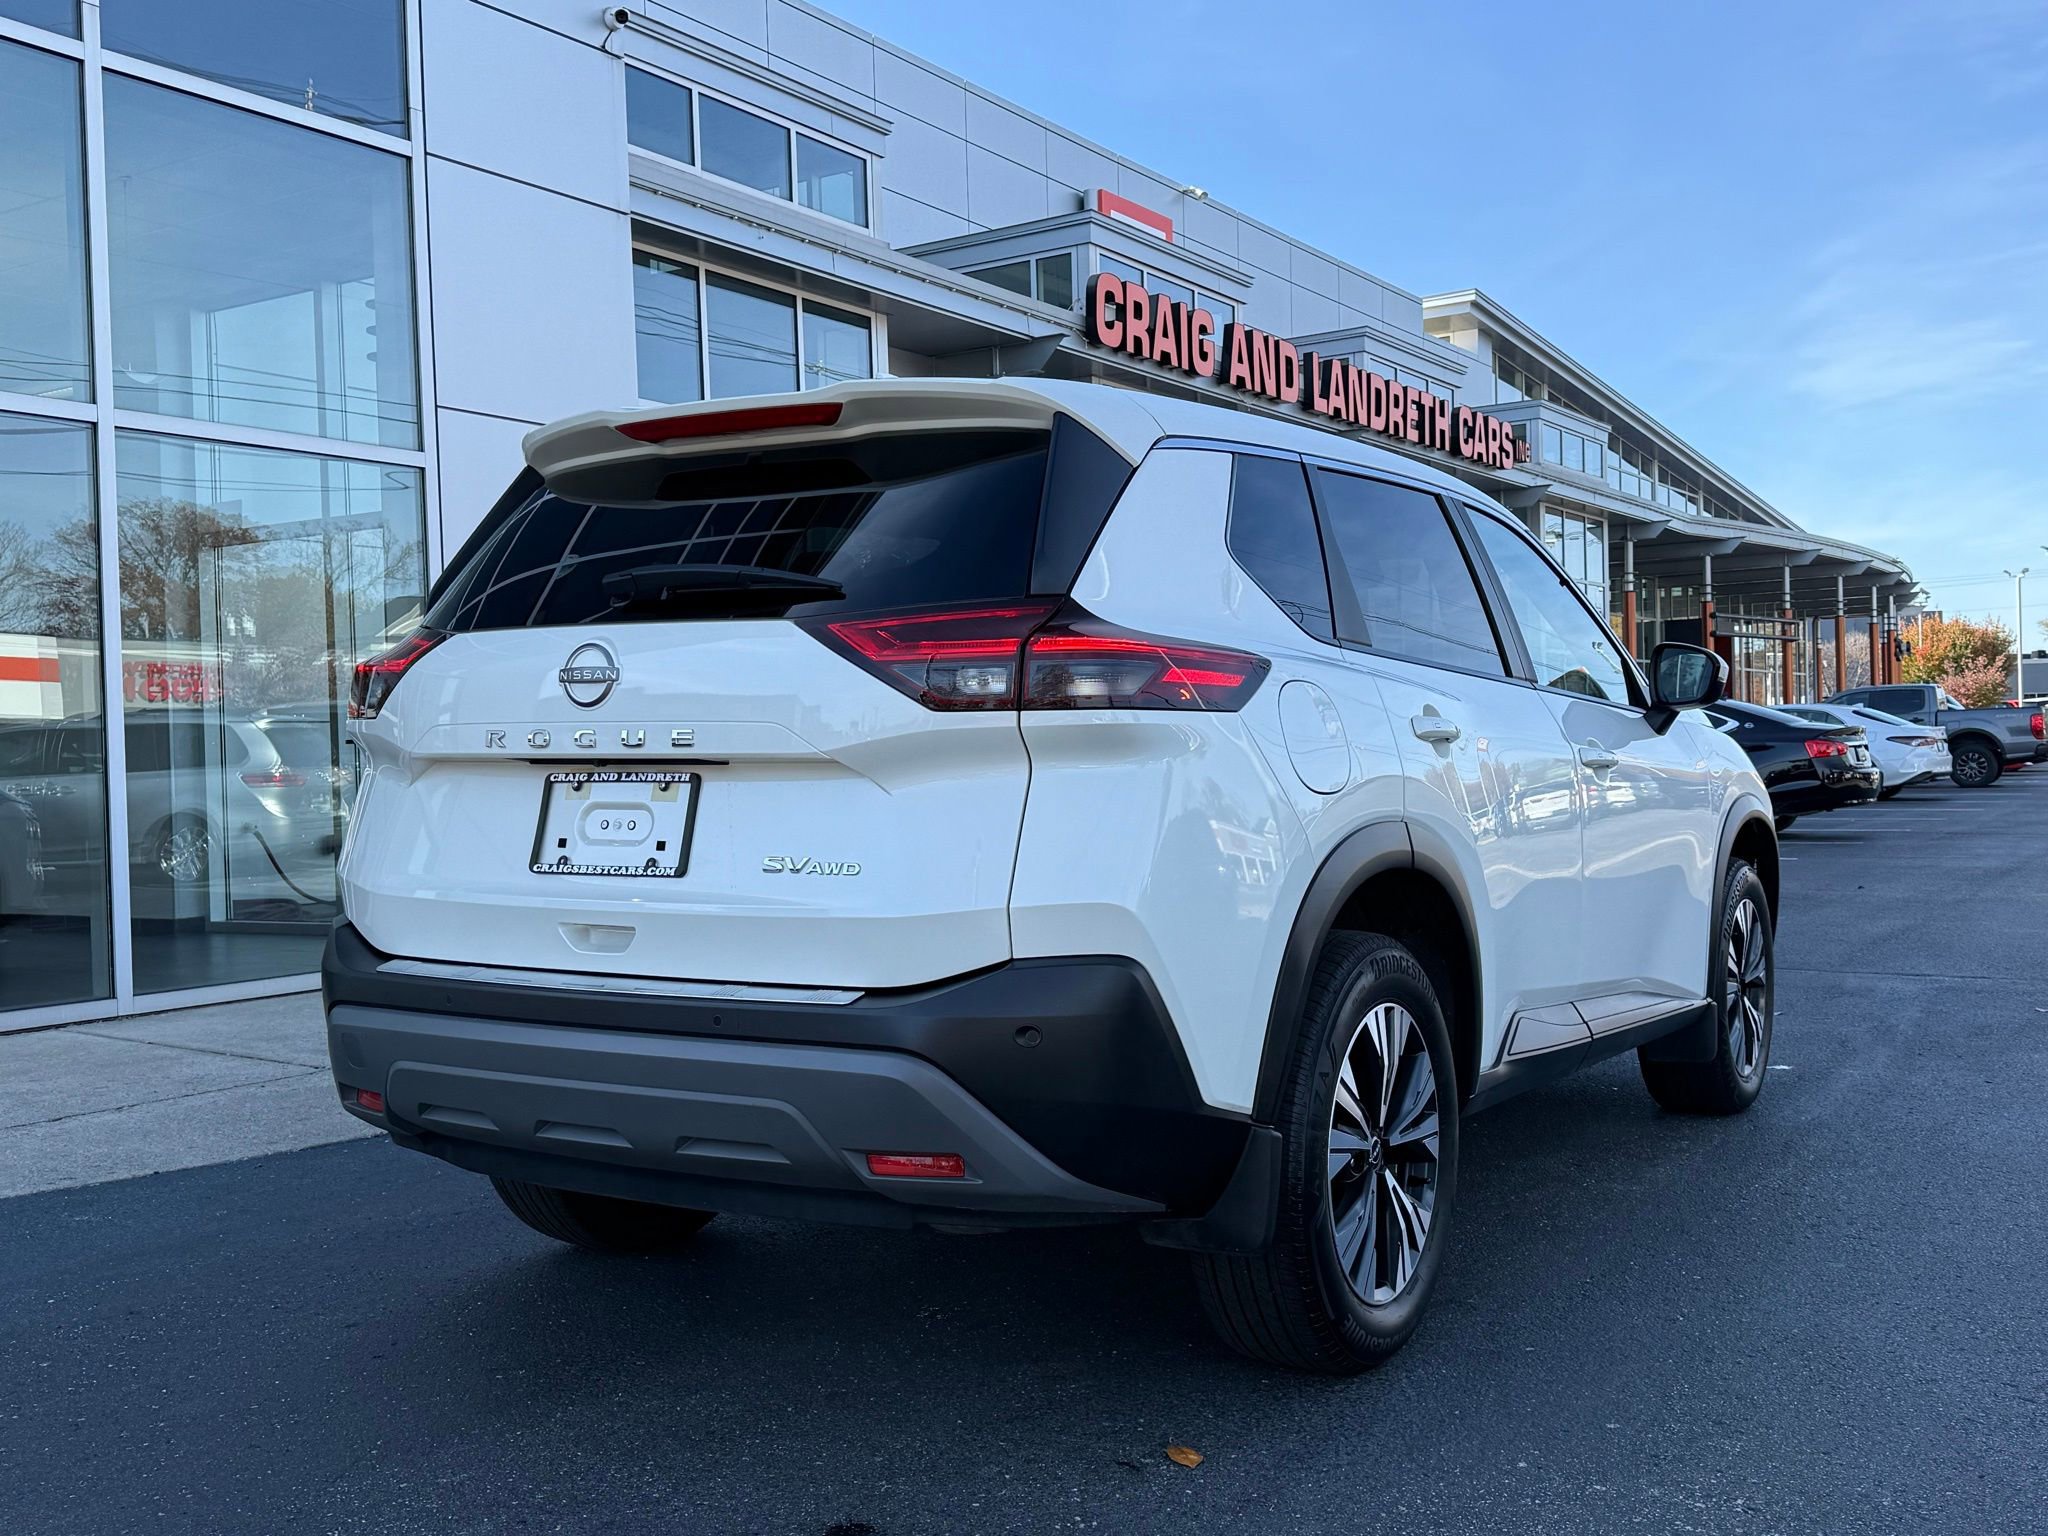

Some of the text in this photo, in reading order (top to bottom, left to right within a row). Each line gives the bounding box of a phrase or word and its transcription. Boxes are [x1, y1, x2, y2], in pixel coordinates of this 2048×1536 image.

[1092, 272, 1215, 378] CRAIG
[1227, 322, 1300, 404] AND
[1310, 351, 1451, 452] LANDRETH
[1457, 404, 1514, 470] CARS
[560, 669, 618, 681] NISSAN
[485, 728, 695, 749] ROGUE
[550, 772, 691, 782] CRAIG AND LANDRETH
[532, 862, 677, 876] CRAIGSBESTCARS.COM
